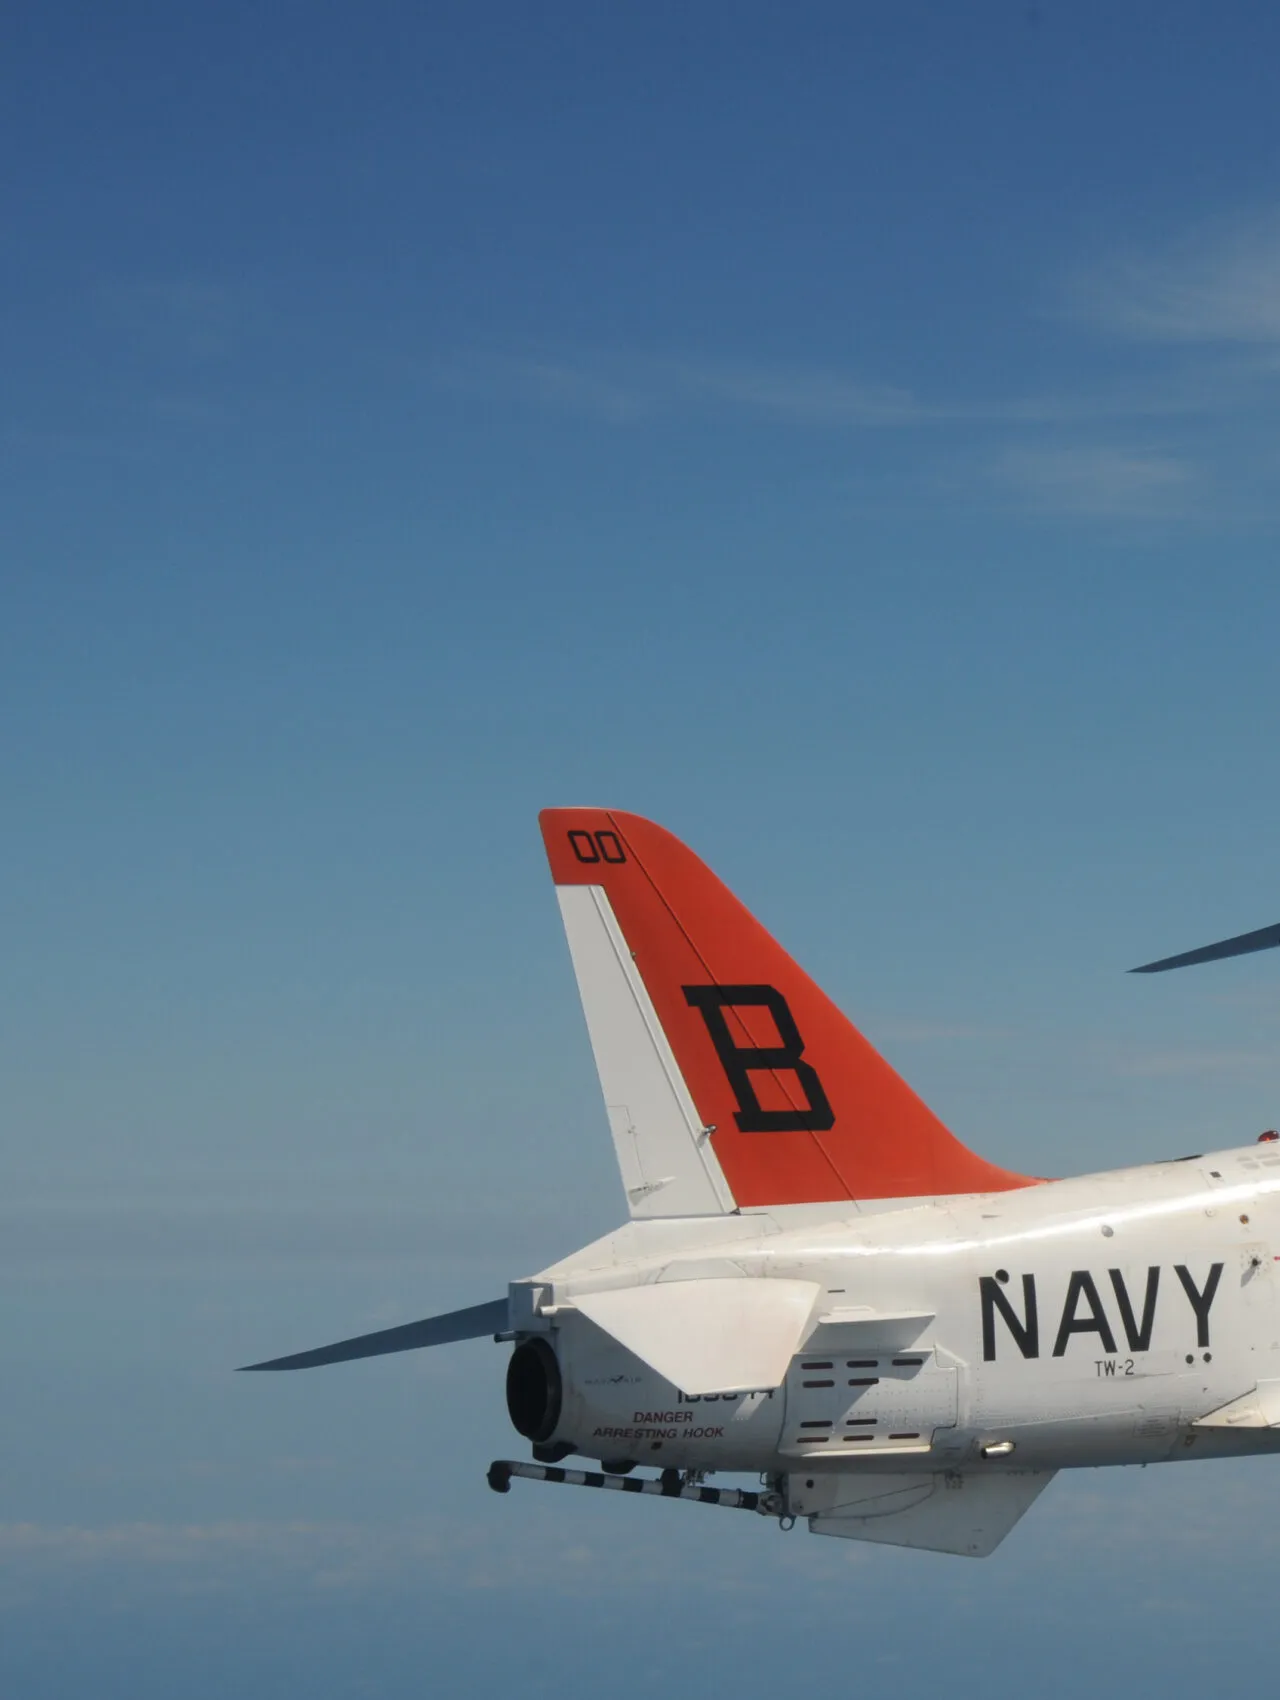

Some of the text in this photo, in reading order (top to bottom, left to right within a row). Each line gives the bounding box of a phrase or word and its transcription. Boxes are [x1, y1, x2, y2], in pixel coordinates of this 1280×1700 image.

[567, 830, 627, 864] 00
[681, 984, 836, 1133] B
[979, 1262, 1225, 1361] NAVY
[1094, 1359, 1135, 1377] TW-2
[633, 1411, 694, 1424] DANGER
[592, 1427, 725, 1439] ARRESTING HOOK
